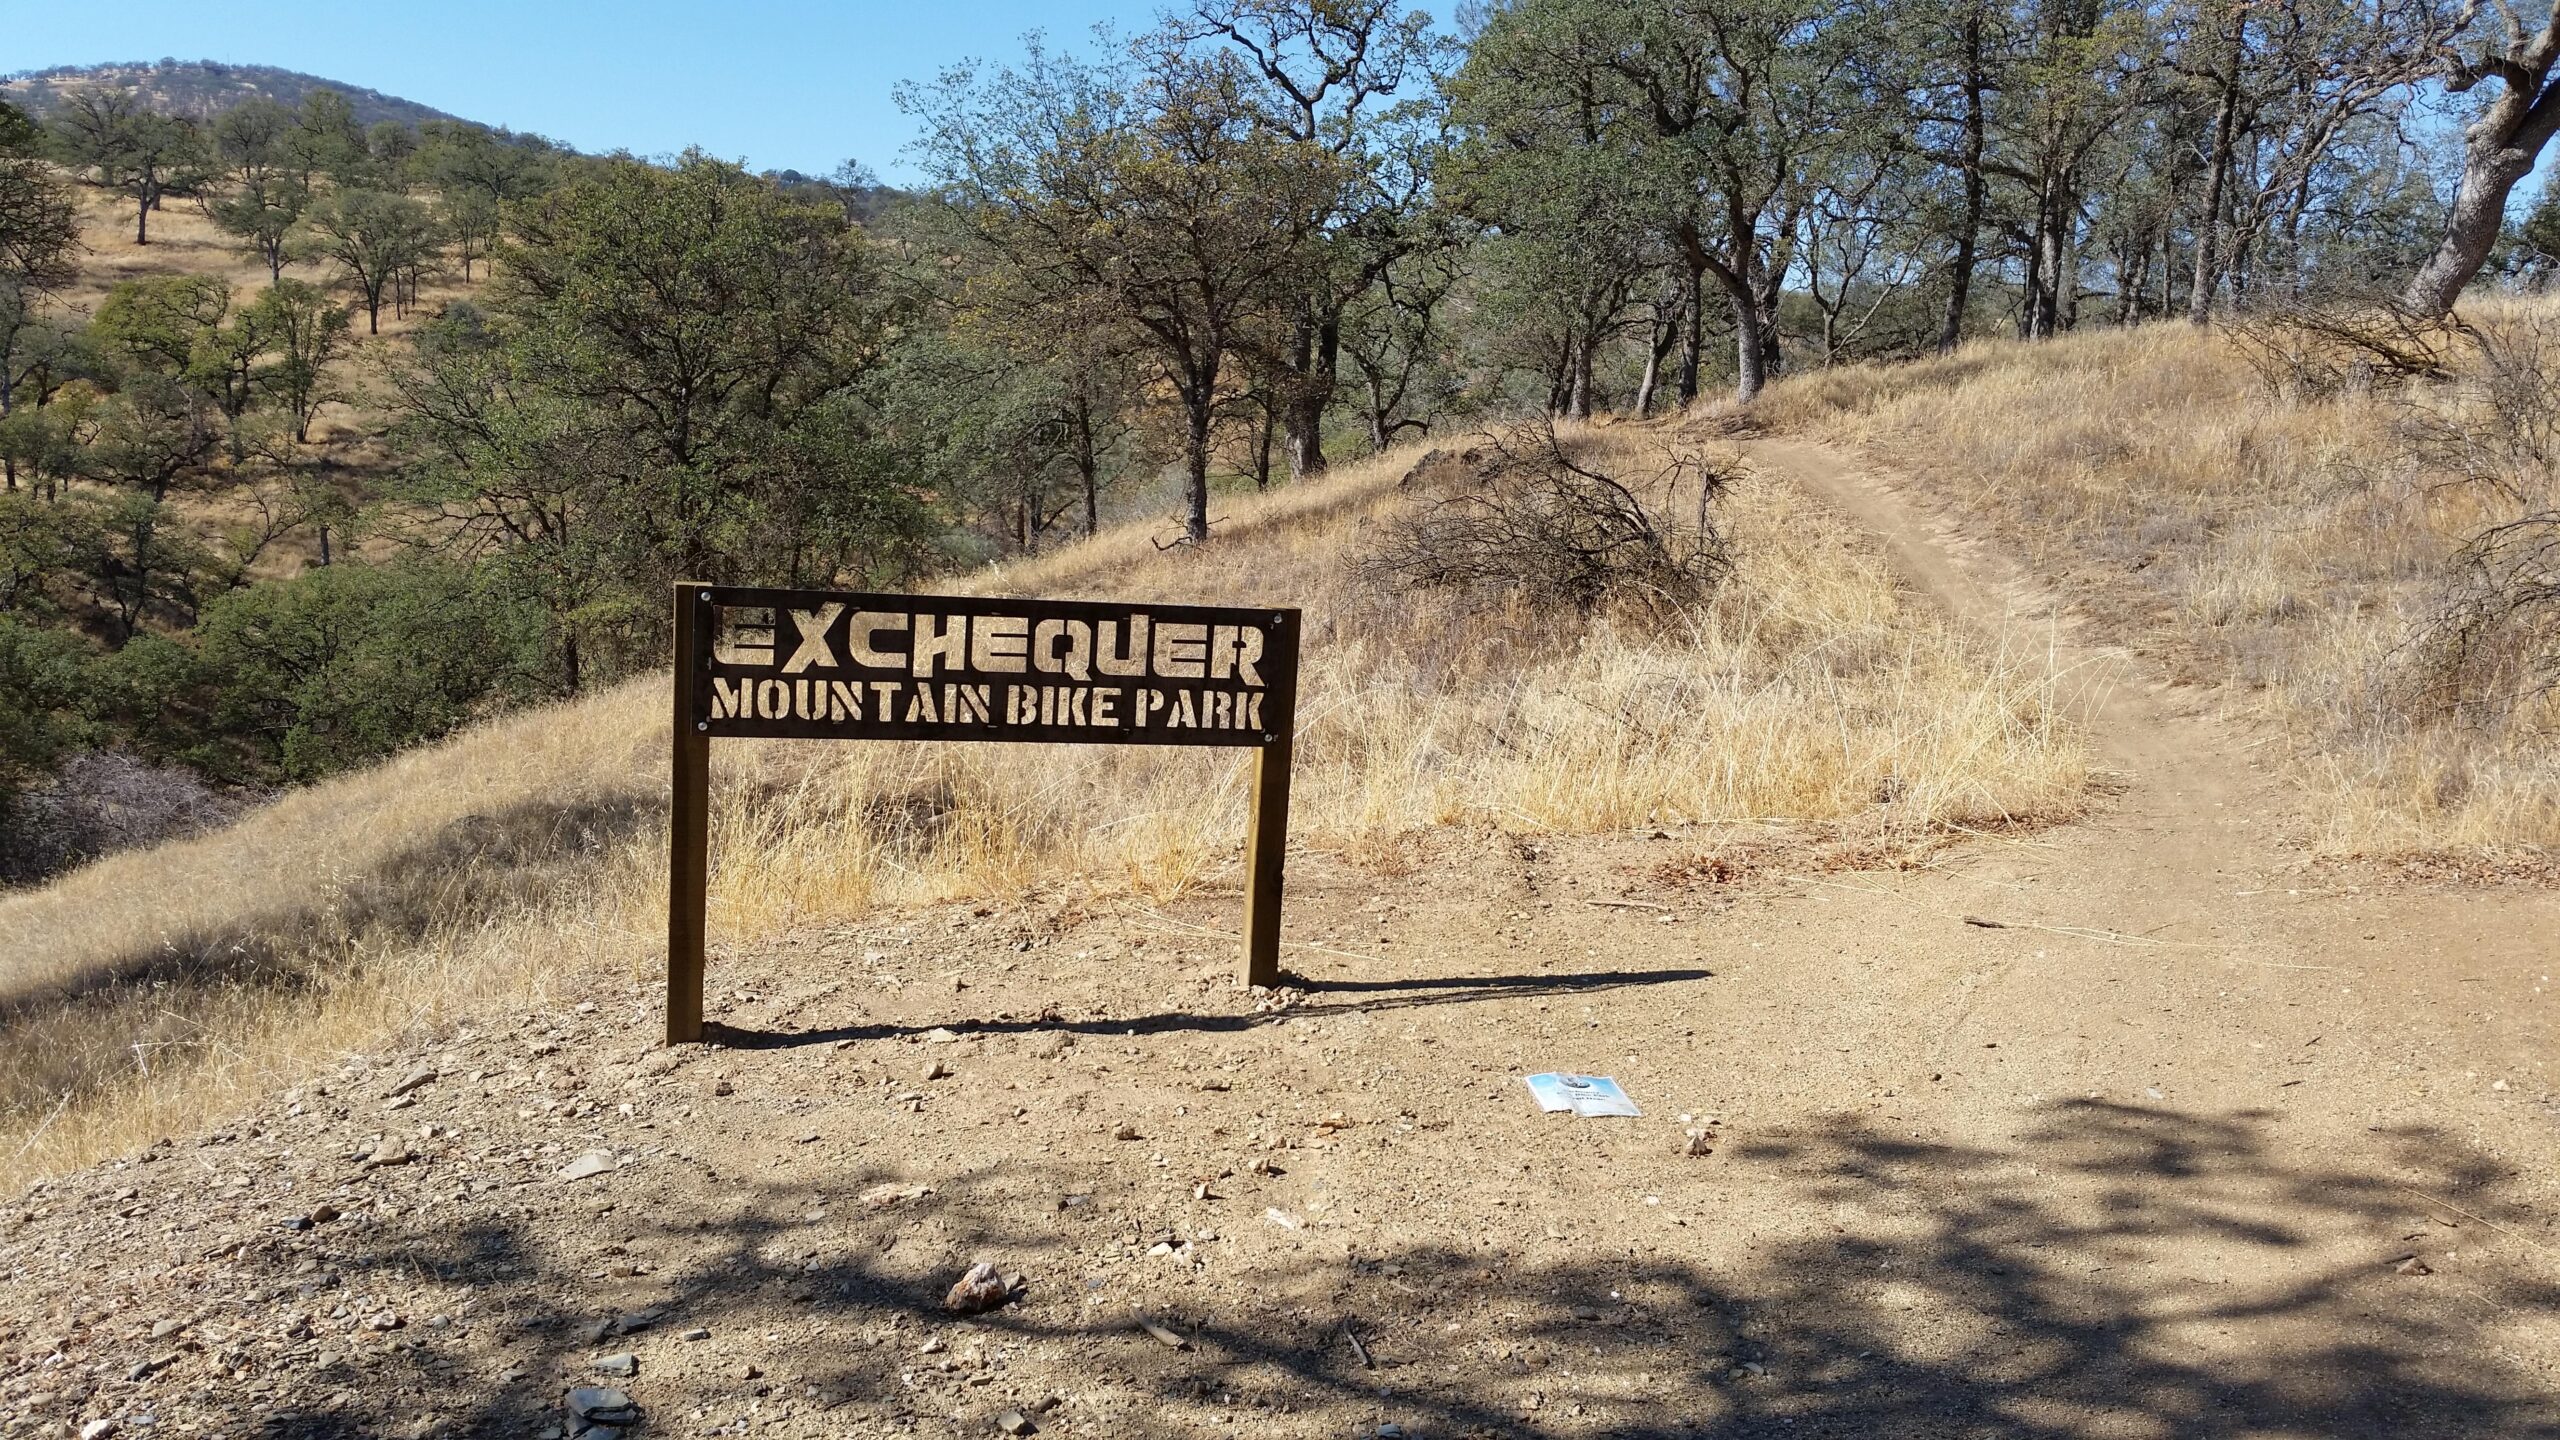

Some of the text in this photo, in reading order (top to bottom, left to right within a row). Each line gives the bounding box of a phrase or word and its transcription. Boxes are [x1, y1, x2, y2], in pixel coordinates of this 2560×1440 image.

[713, 601, 1265, 686] EXCHEQUER
[712, 678, 1264, 730] MOUNTAIN BIKE PARK
